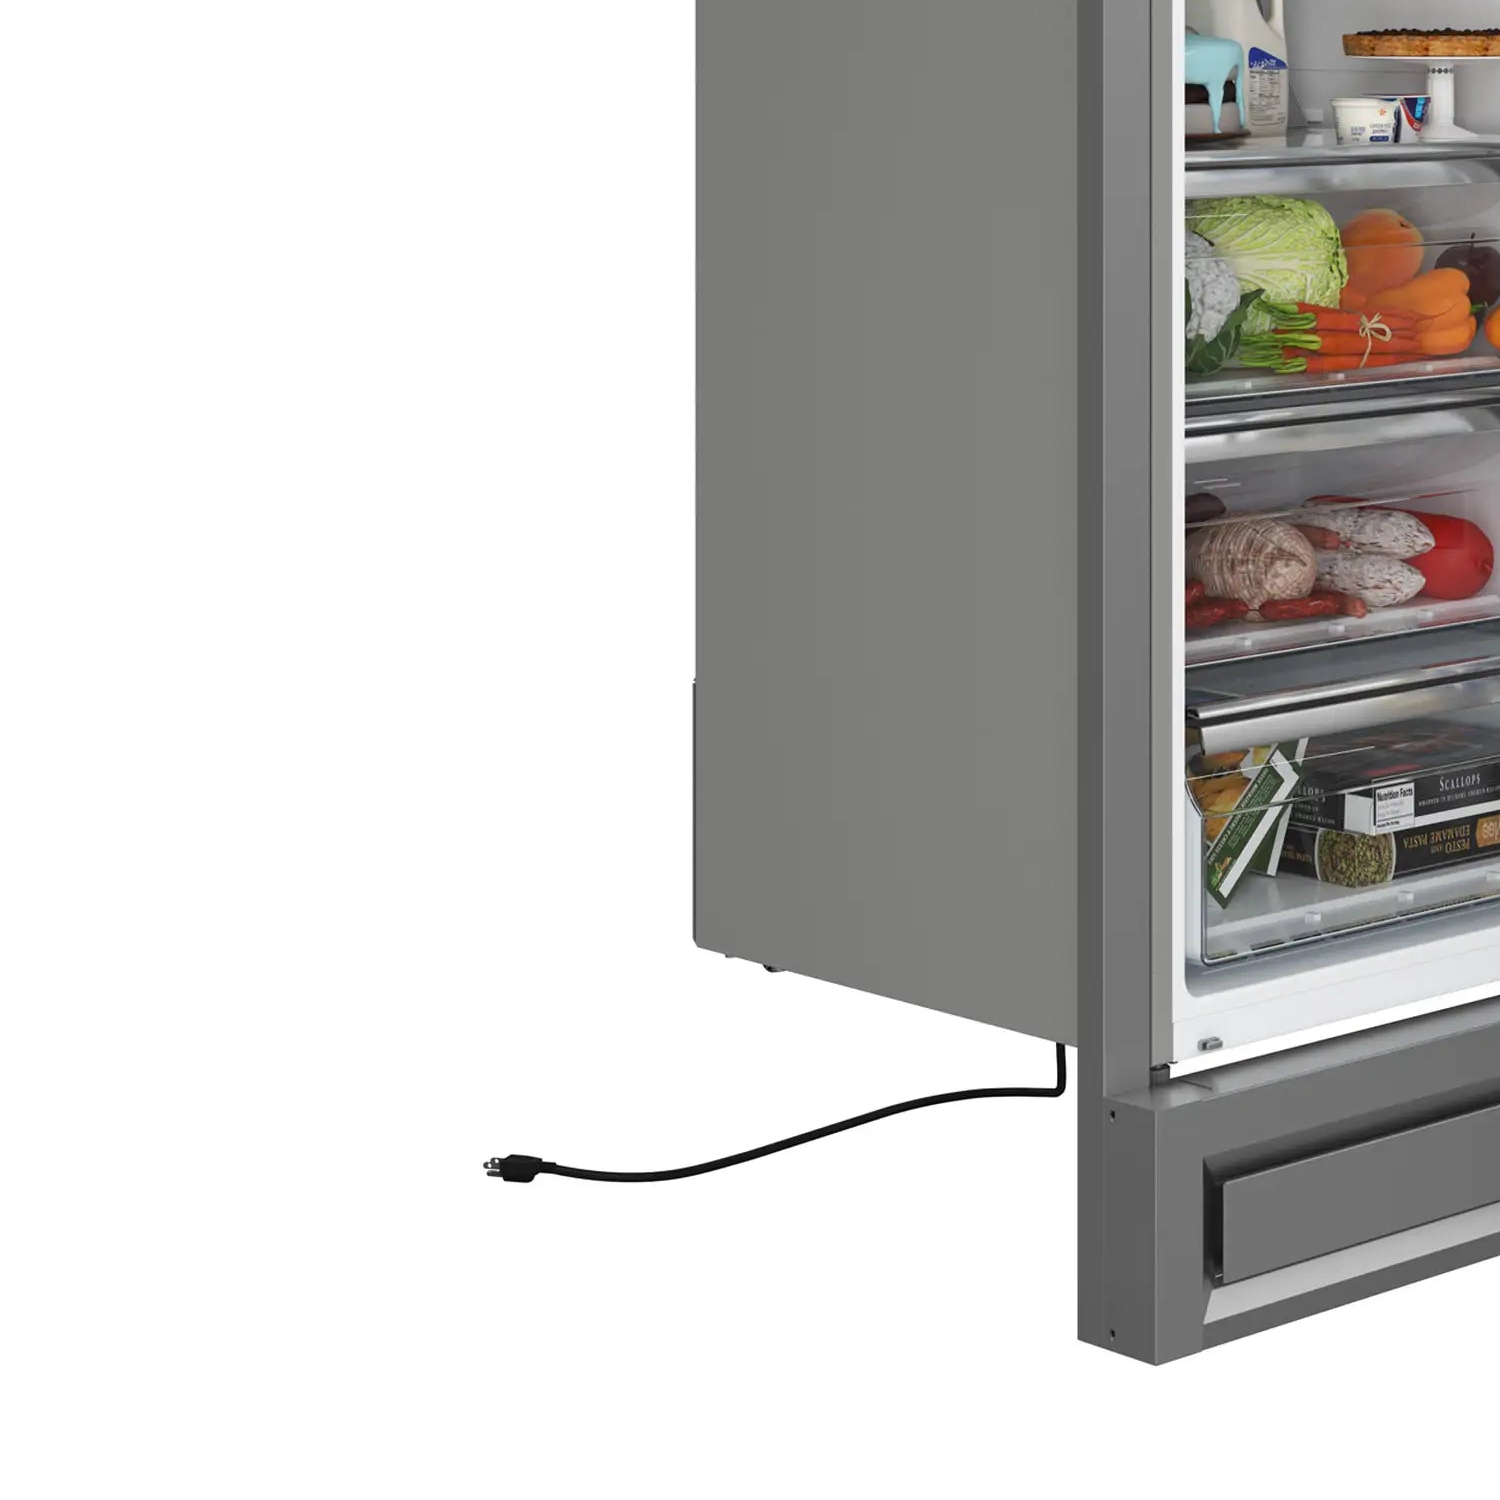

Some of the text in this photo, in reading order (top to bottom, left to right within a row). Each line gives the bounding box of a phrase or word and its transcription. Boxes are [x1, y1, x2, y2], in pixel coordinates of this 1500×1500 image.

[1440, 773, 1481, 792] SCALLOPS
[1377, 787, 1413, 801] Nutrition Facts
[1402, 832, 1429, 848] PASTA
[1445, 839, 1471, 854] PESTO
